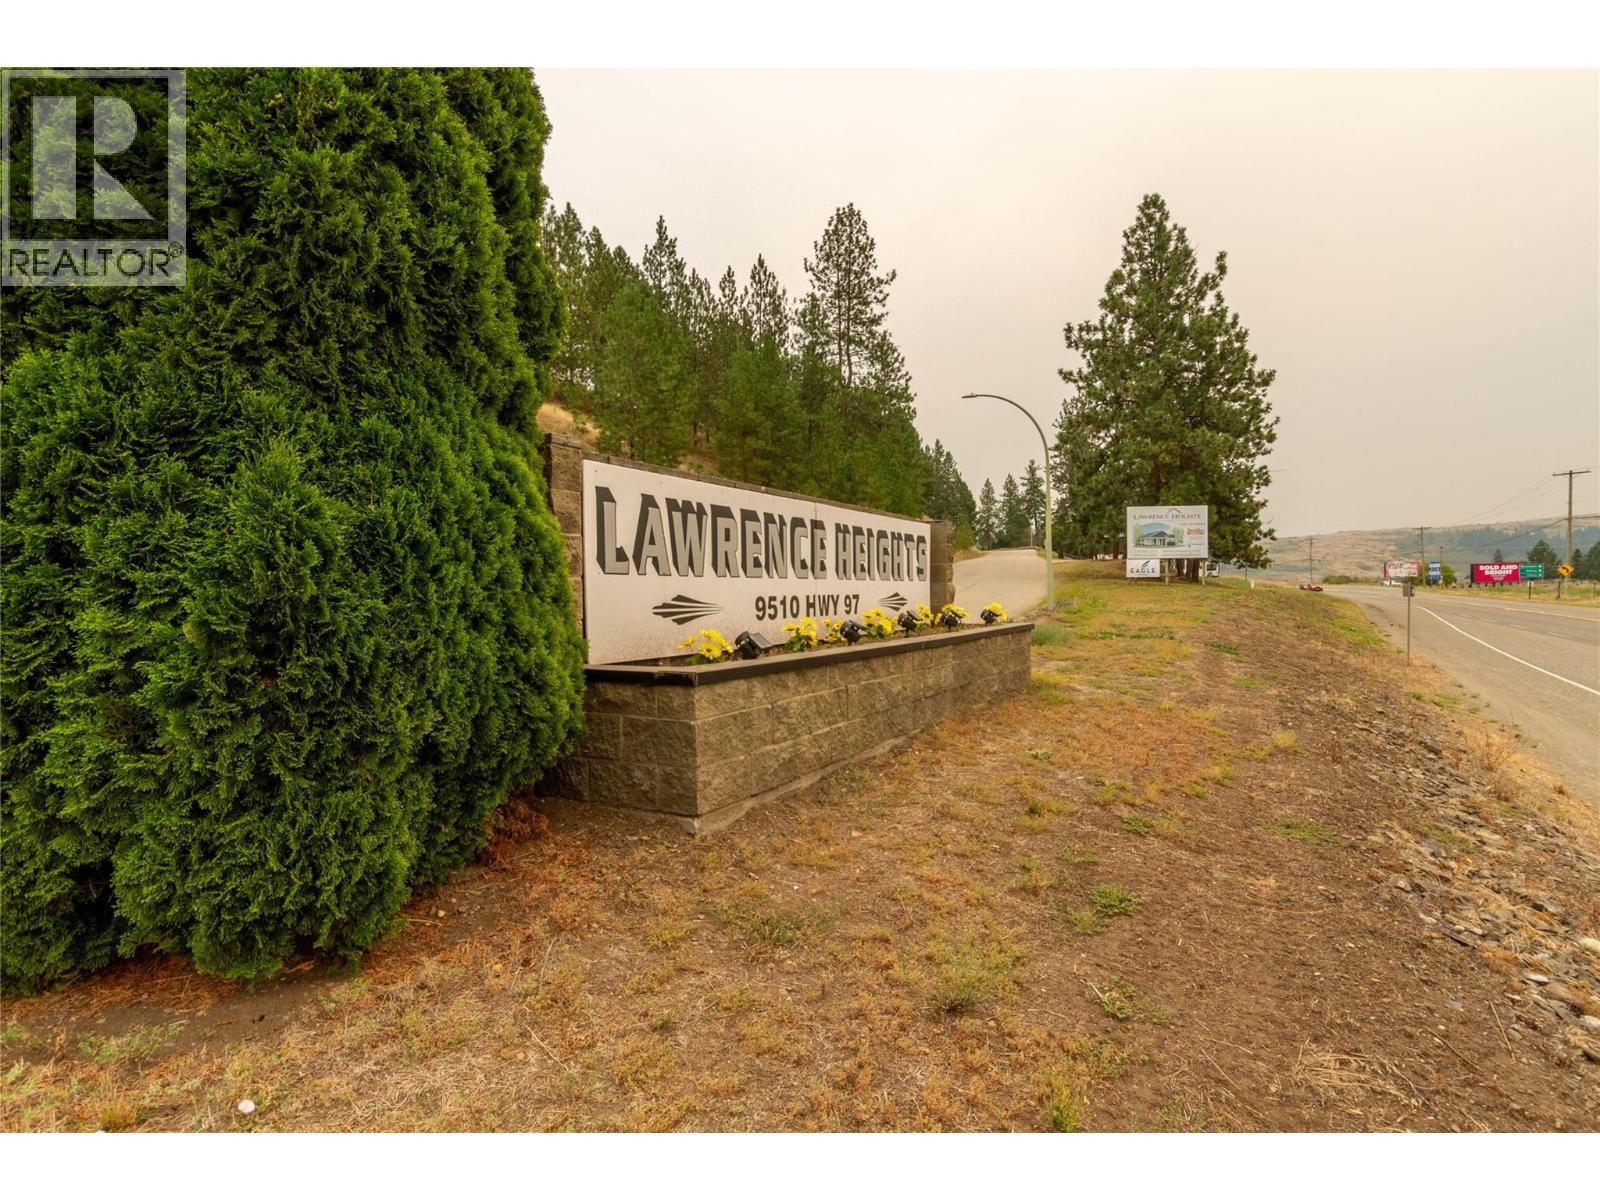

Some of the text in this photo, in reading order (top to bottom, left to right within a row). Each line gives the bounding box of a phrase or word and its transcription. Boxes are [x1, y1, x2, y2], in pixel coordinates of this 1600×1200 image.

[1133, 513, 1169, 521] LAWRENCE
[595, 486, 928, 582] LAWRENCE HEIGHTS
[755, 594, 860, 621] 9510 HWY 97
